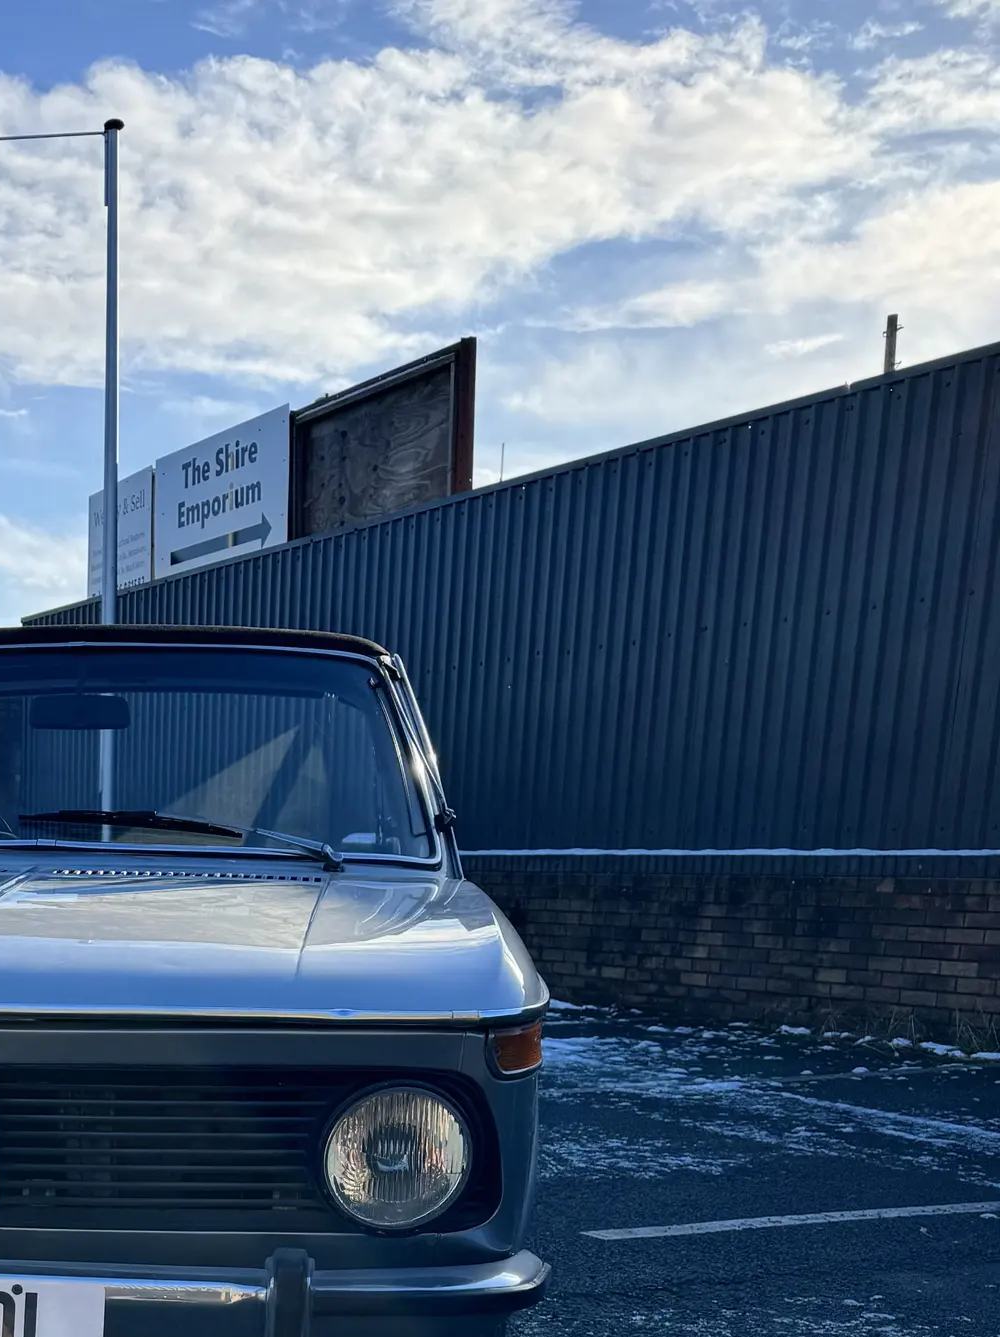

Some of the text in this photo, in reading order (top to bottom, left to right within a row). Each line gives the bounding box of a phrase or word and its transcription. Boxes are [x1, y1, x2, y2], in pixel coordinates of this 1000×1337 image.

[182, 439, 258, 490] The Shire
[130, 489, 145, 512] Sell
[177, 480, 262, 530] Emporium
